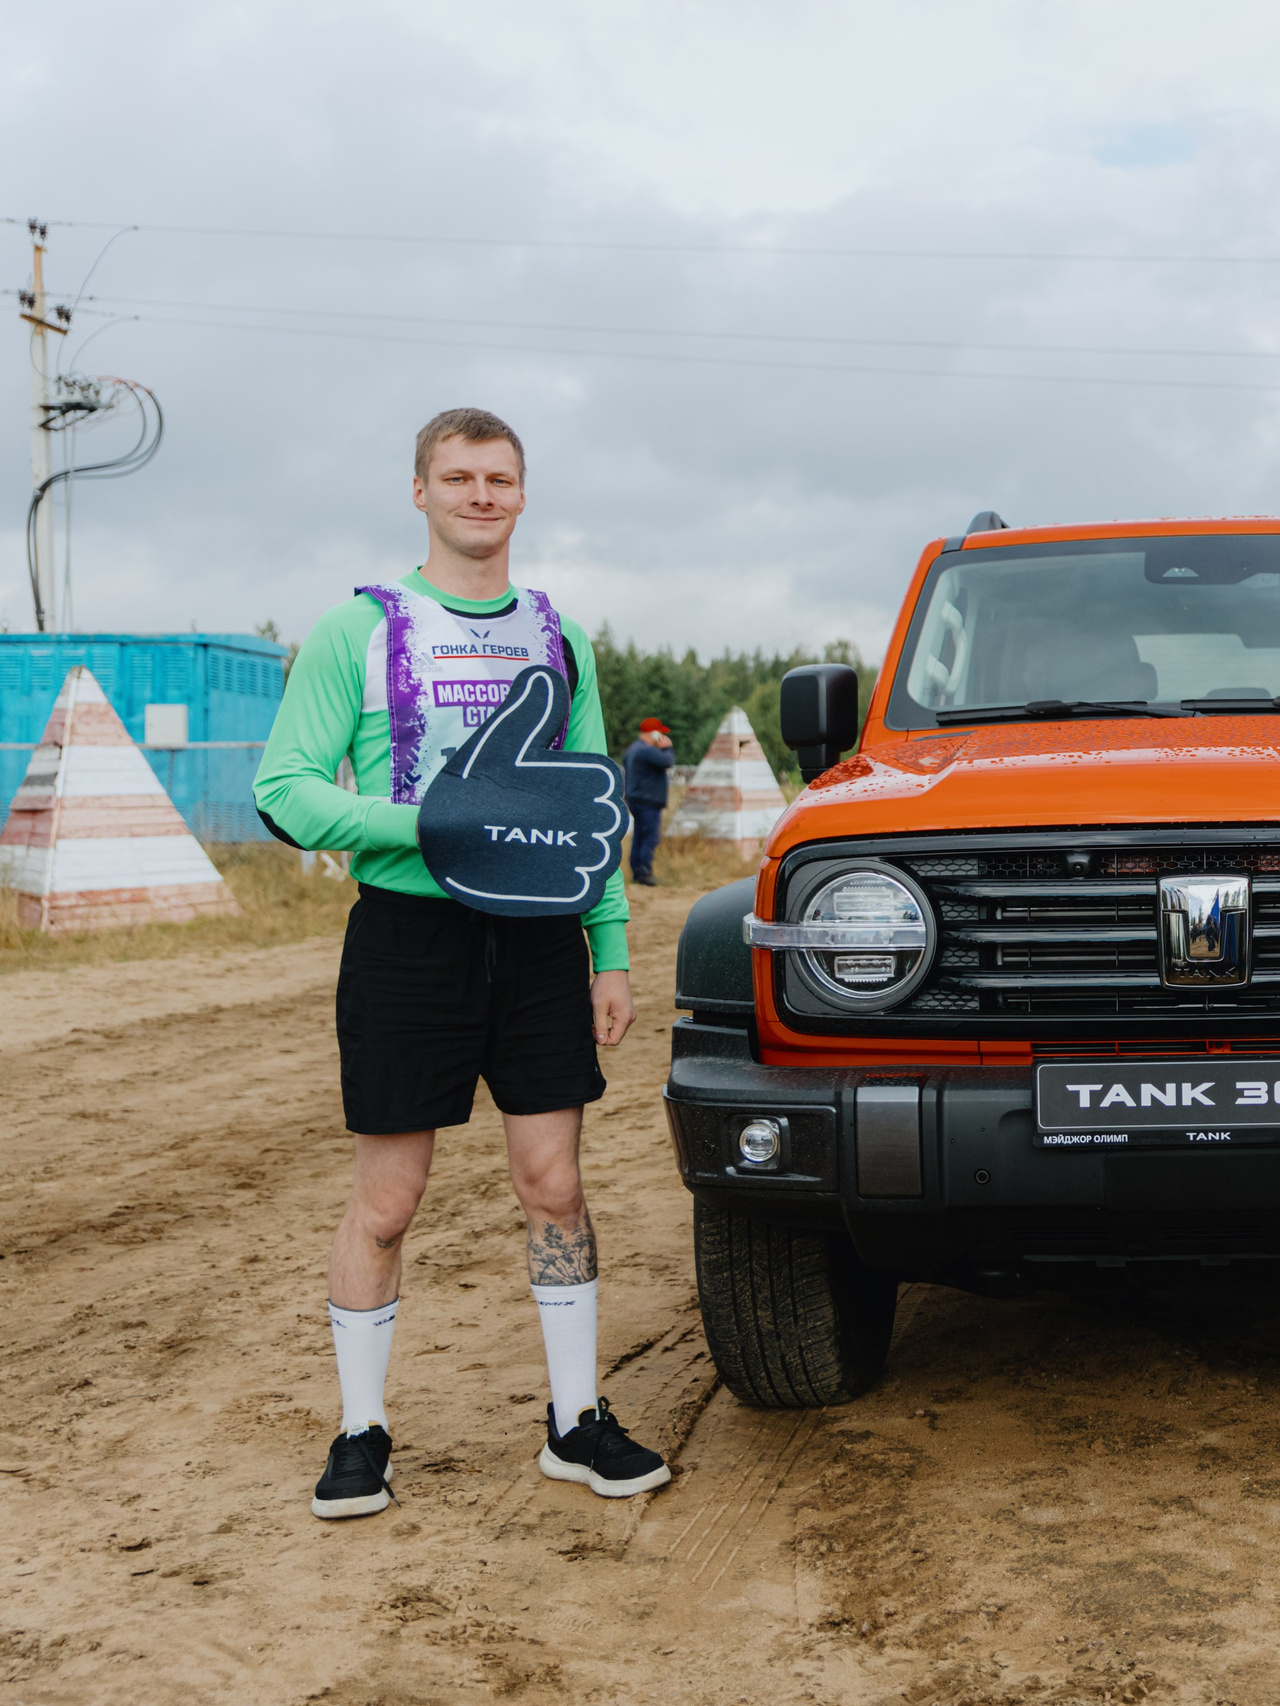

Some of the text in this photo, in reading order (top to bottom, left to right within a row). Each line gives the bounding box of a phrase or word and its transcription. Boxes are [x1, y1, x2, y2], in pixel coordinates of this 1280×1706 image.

[432, 644, 529, 657] ГОНКА ГЕРОЕВ
[436, 683, 512, 704] МАССОВ
[484, 825, 578, 847] TANK
[1175, 967, 1236, 978] TANK
[1066, 1082, 1216, 1108] TANK
[1043, 1133, 1128, 1145] МЭЙДЖОР ОЛИМП
[1186, 1131, 1231, 1141] TANK
